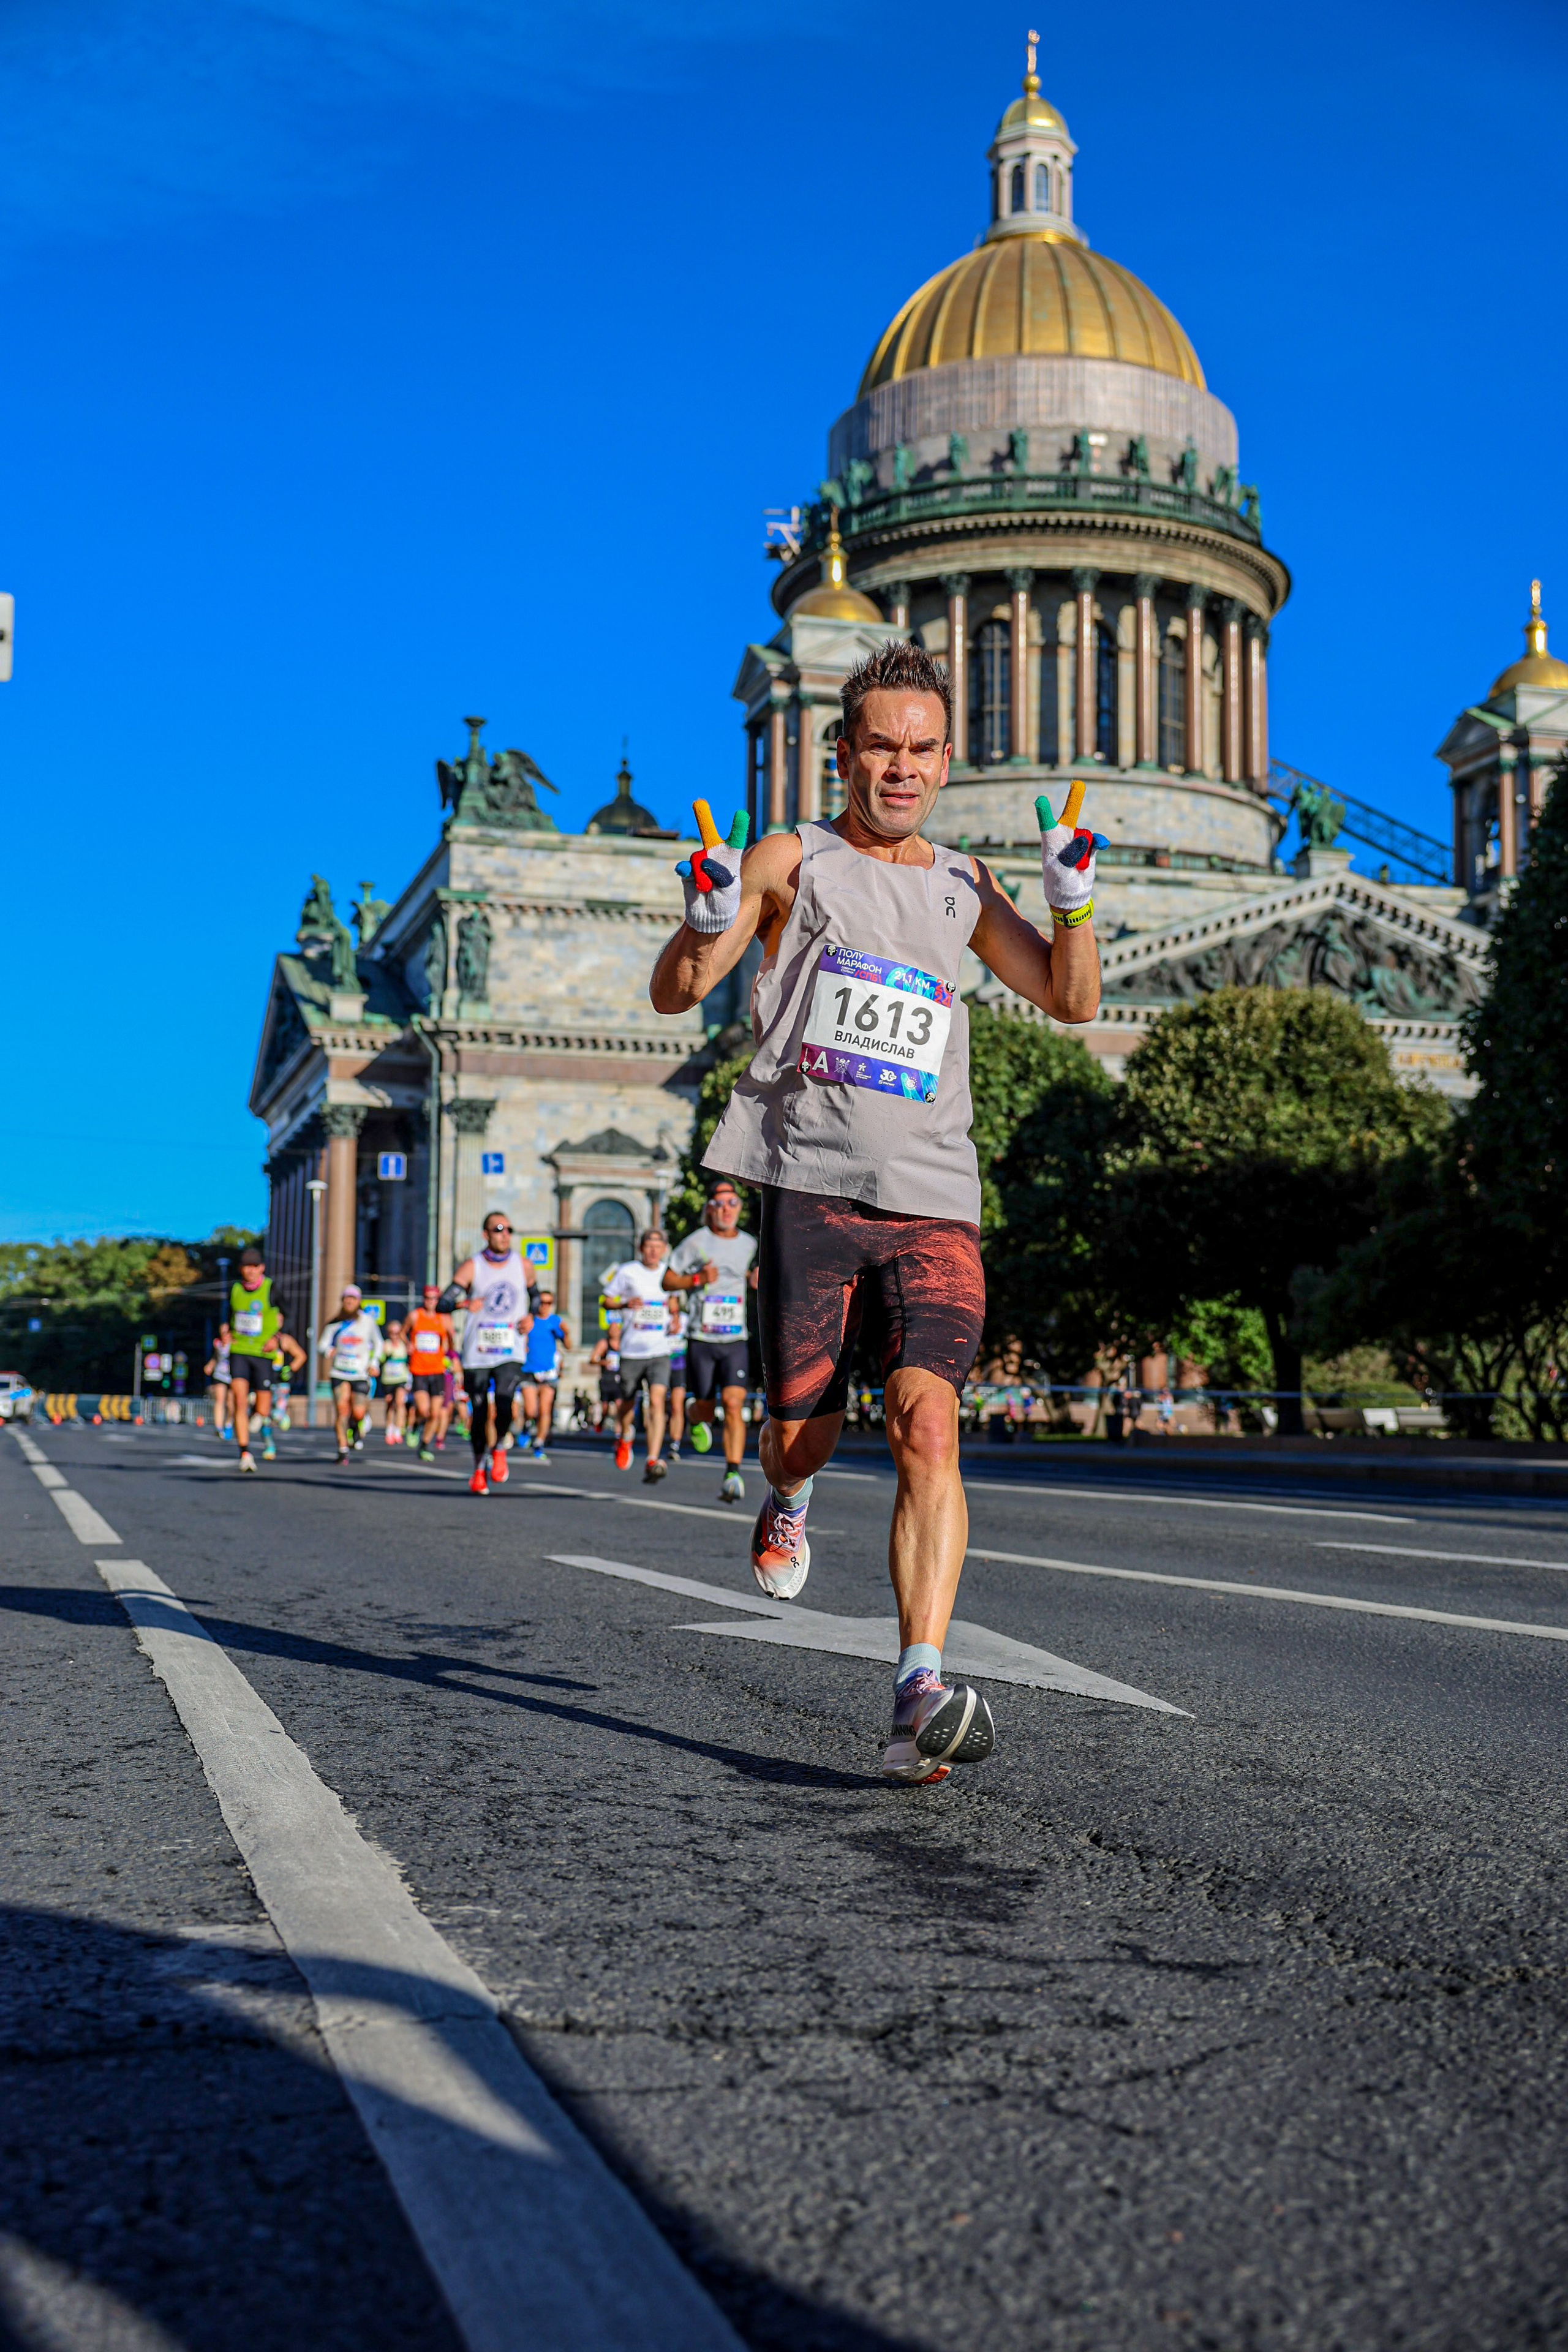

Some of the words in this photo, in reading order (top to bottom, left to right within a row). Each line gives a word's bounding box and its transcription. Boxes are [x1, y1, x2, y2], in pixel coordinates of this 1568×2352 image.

[839, 949, 864, 960] ПОЛУ
[837, 957, 882, 974] МАРАФОН
[934, 990, 951, 1008] 24
[835, 987, 933, 1046] 1613
[834, 1030, 915, 1059] ВЛАДИСЛАВ
[891, 1724, 917, 1736] UNNING
